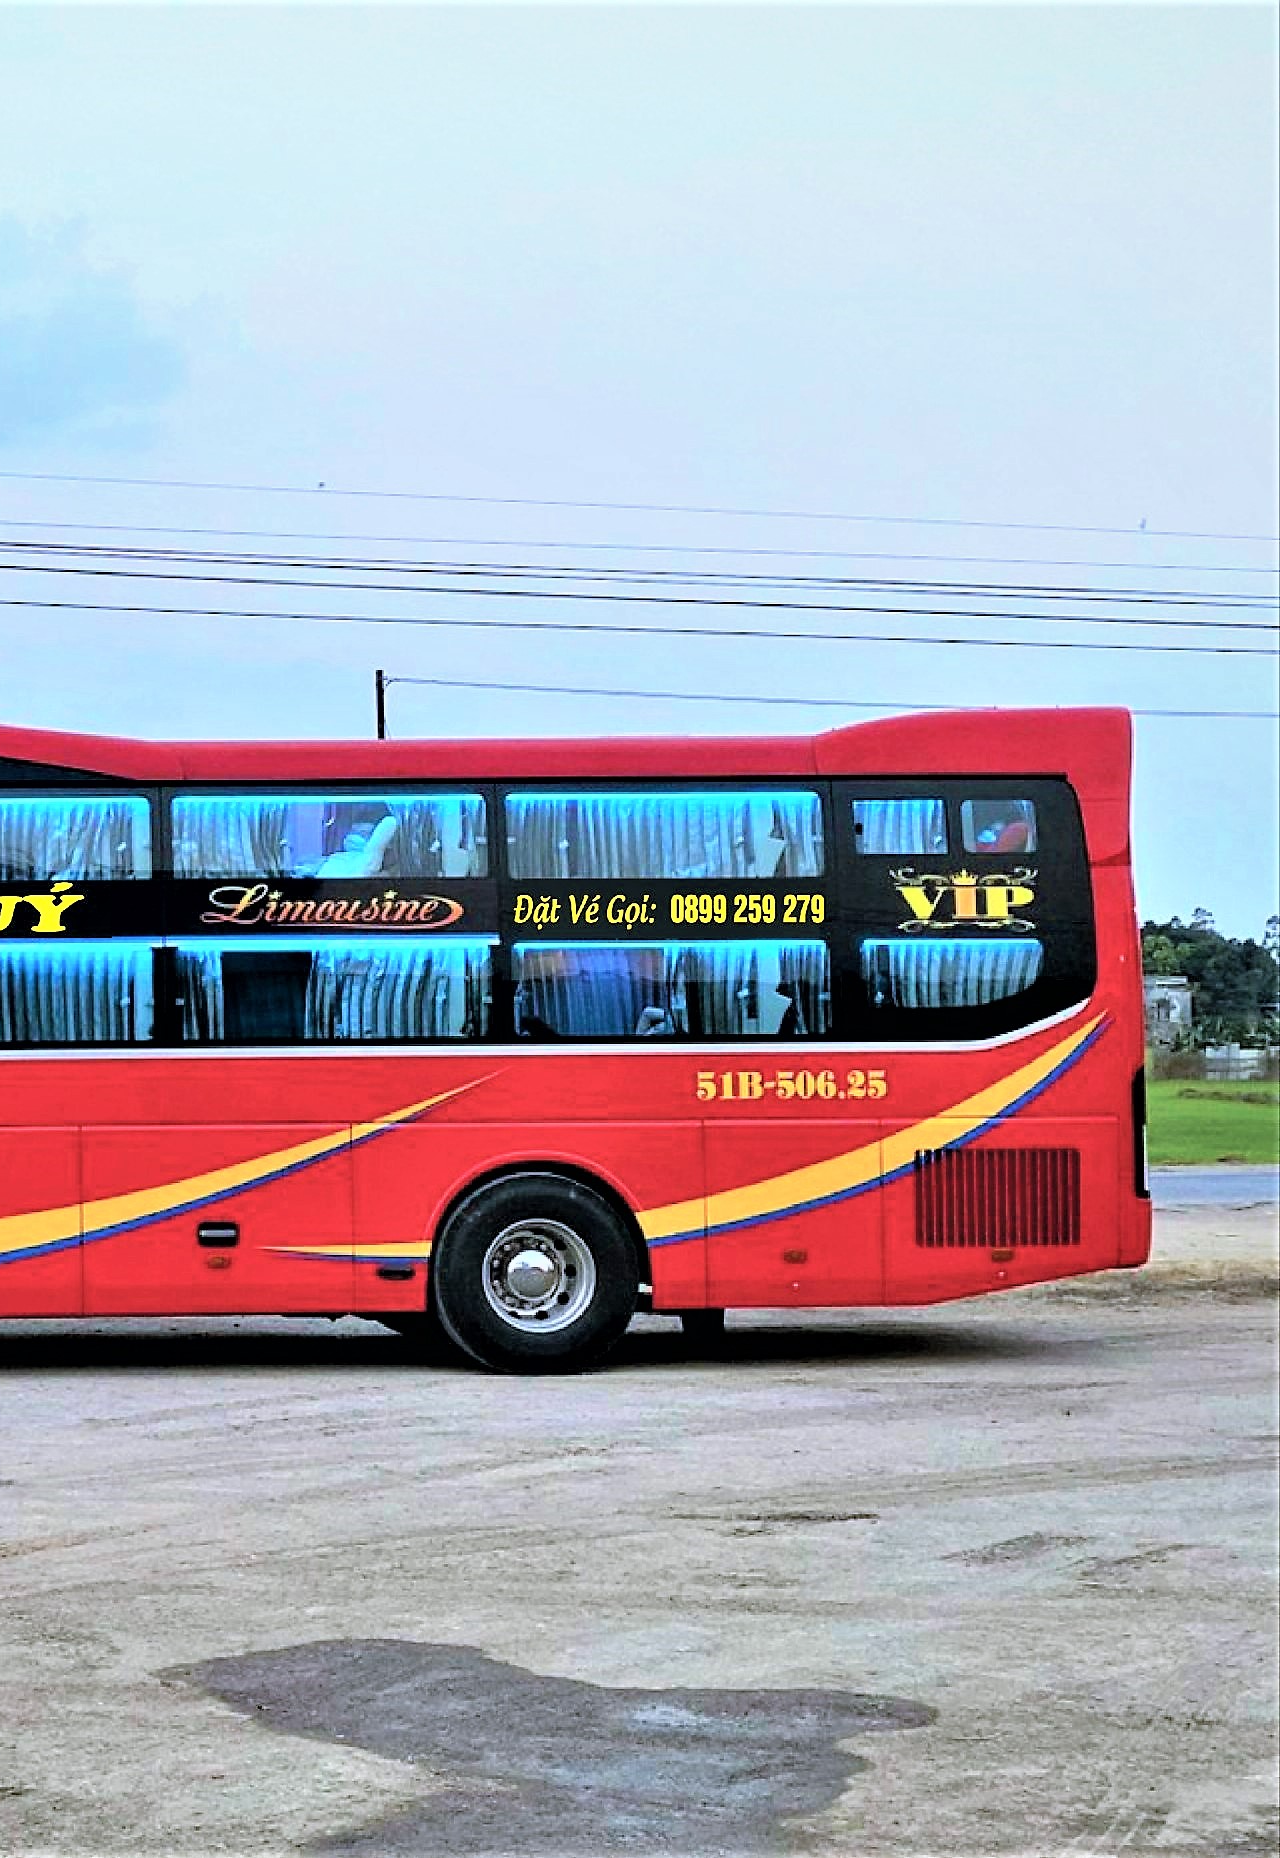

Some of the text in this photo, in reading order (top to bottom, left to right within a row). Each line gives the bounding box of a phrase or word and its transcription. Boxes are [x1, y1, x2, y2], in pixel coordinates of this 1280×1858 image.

[200, 884, 464, 928] Limousine
[513, 894, 825, 930] Đặt Vé Gọi: 0899 259 279
[895, 886, 1035, 919] VIP
[696, 1069, 888, 1100] 51B-506.25
